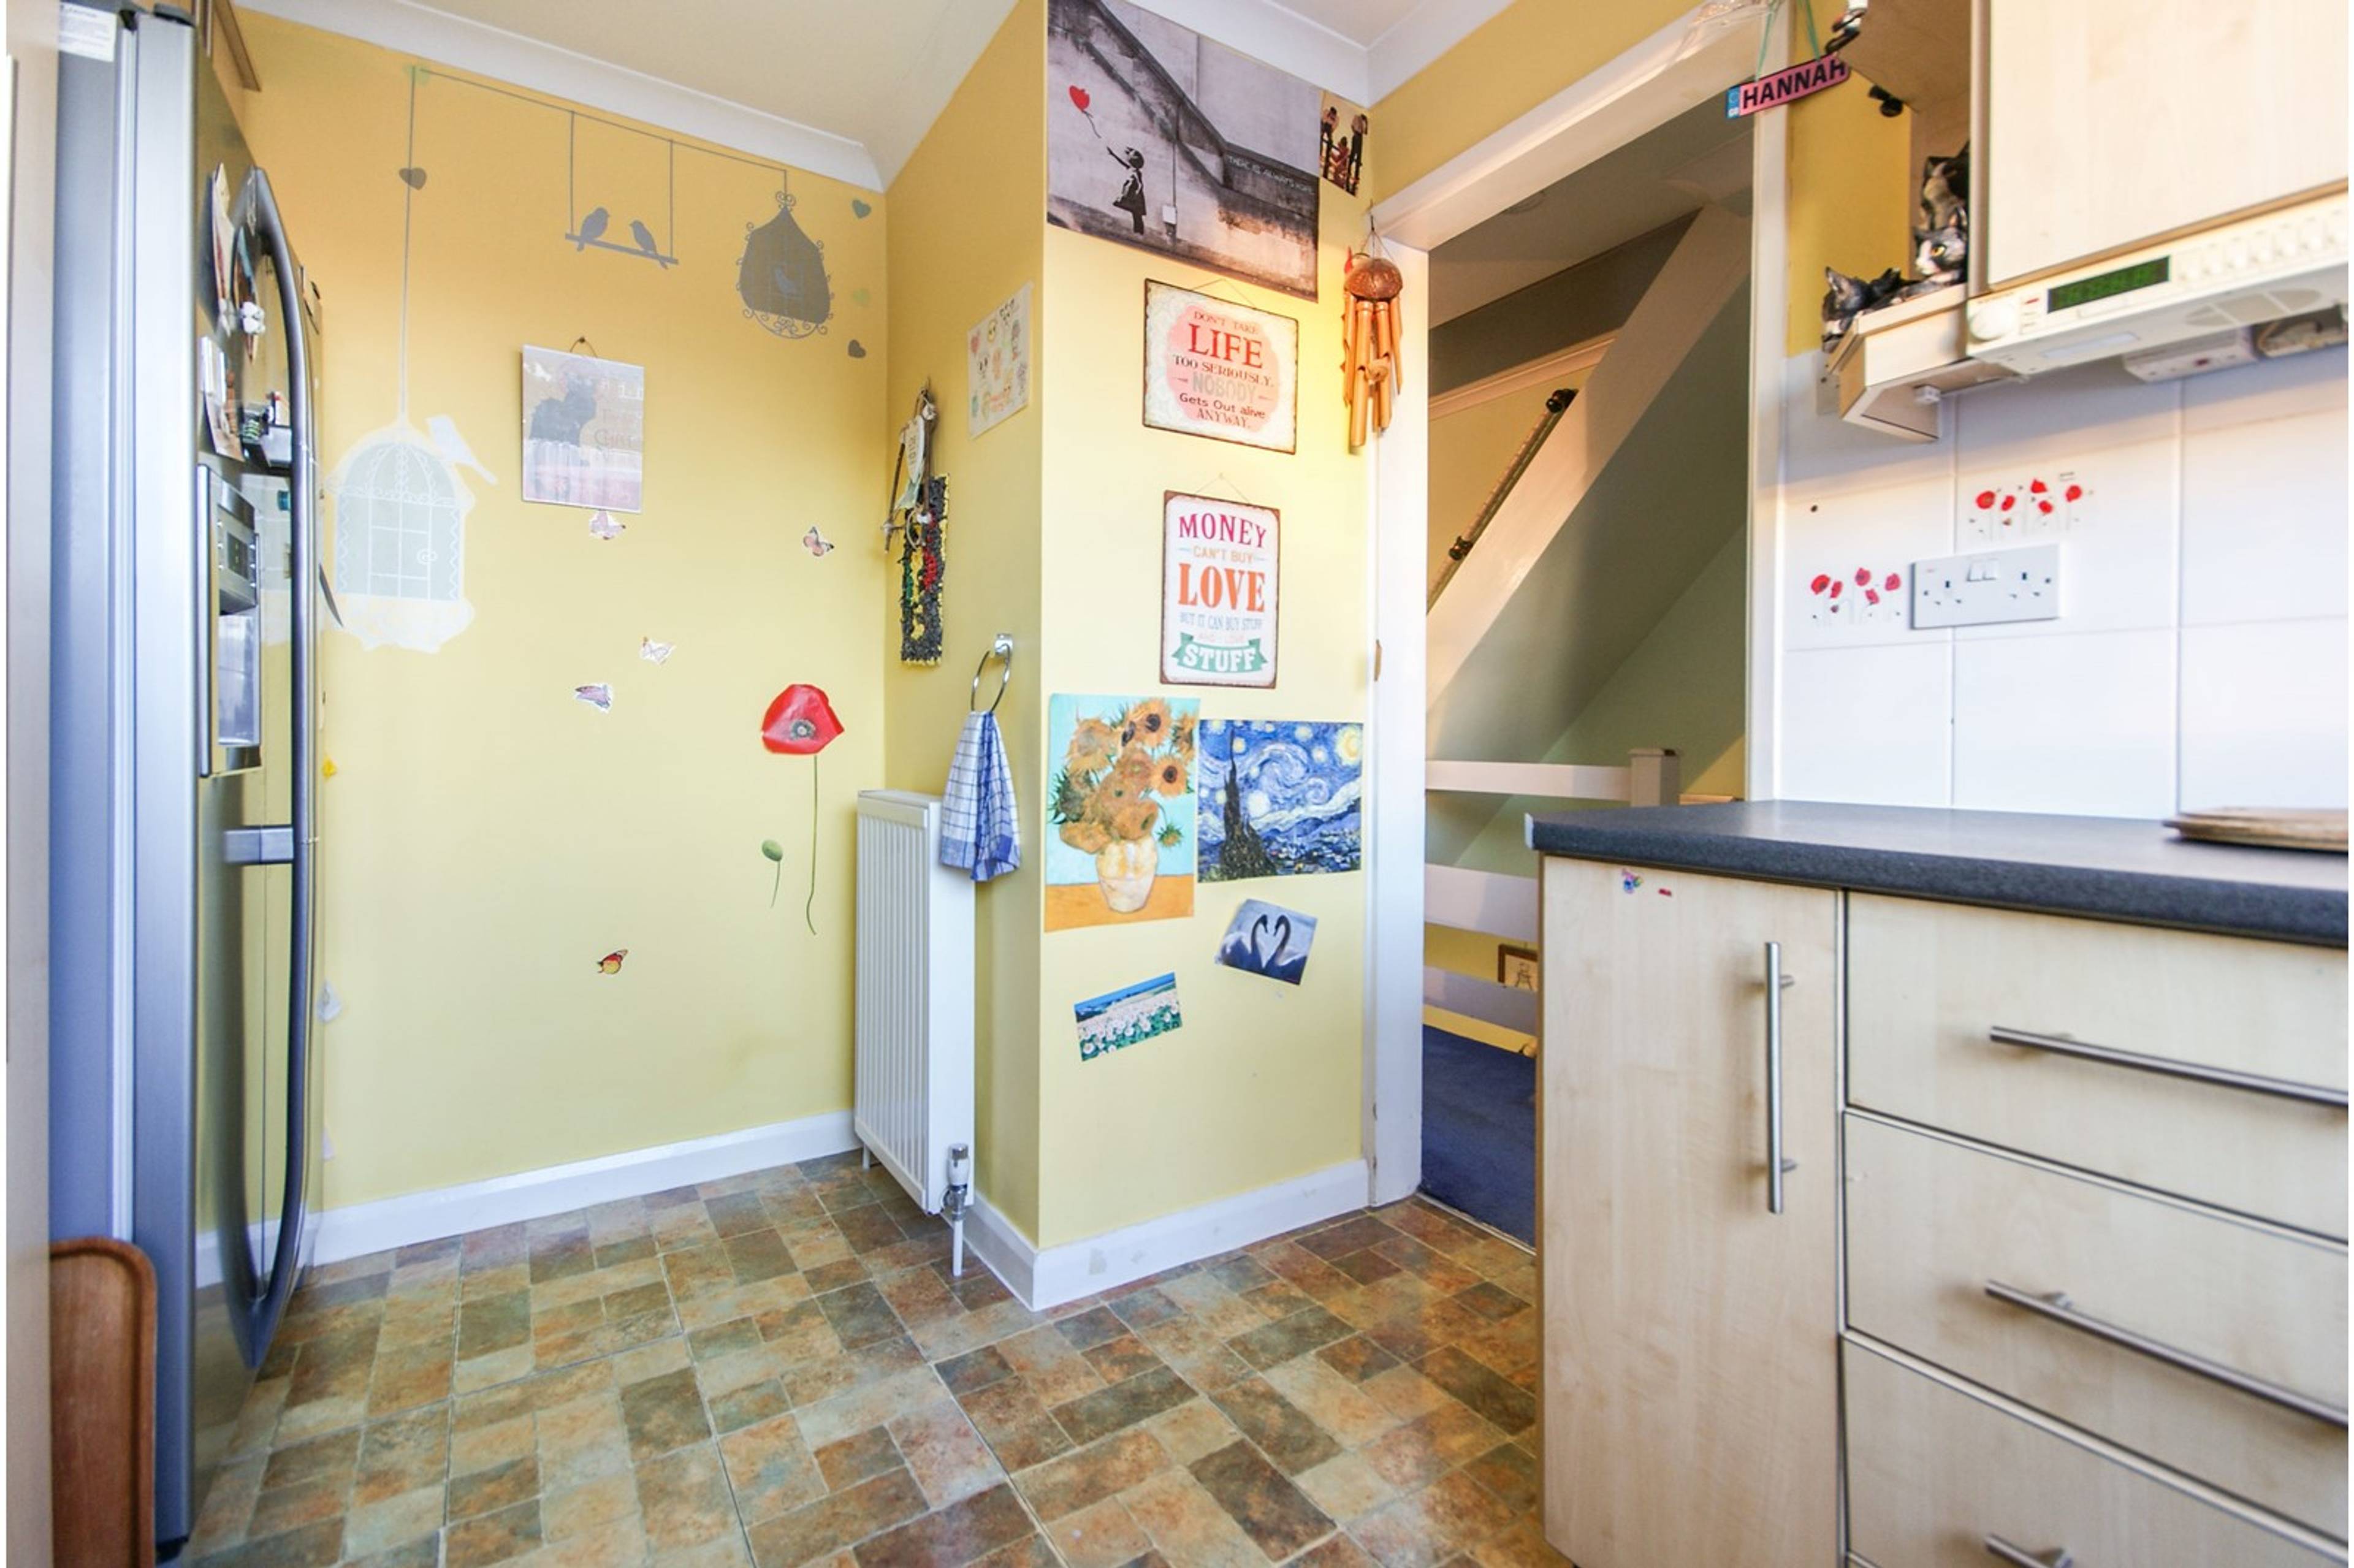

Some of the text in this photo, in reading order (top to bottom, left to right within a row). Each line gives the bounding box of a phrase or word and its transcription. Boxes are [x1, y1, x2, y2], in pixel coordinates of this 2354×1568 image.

[1743, 59, 1846, 109] HANNAH
[1195, 311, 1258, 334] DON'T TAKE
[1188, 323, 1263, 368] LIFE
[1173, 354, 1198, 368] TOO
[1192, 372, 1256, 404] NOBODY
[1179, 392, 1266, 419] Gets Out alive
[1179, 512, 1267, 547] MONEY
[1193, 545, 1254, 563] CAN'T BUY
[1178, 563, 1265, 612] LOVE
[1183, 643, 1257, 672] STUFF
